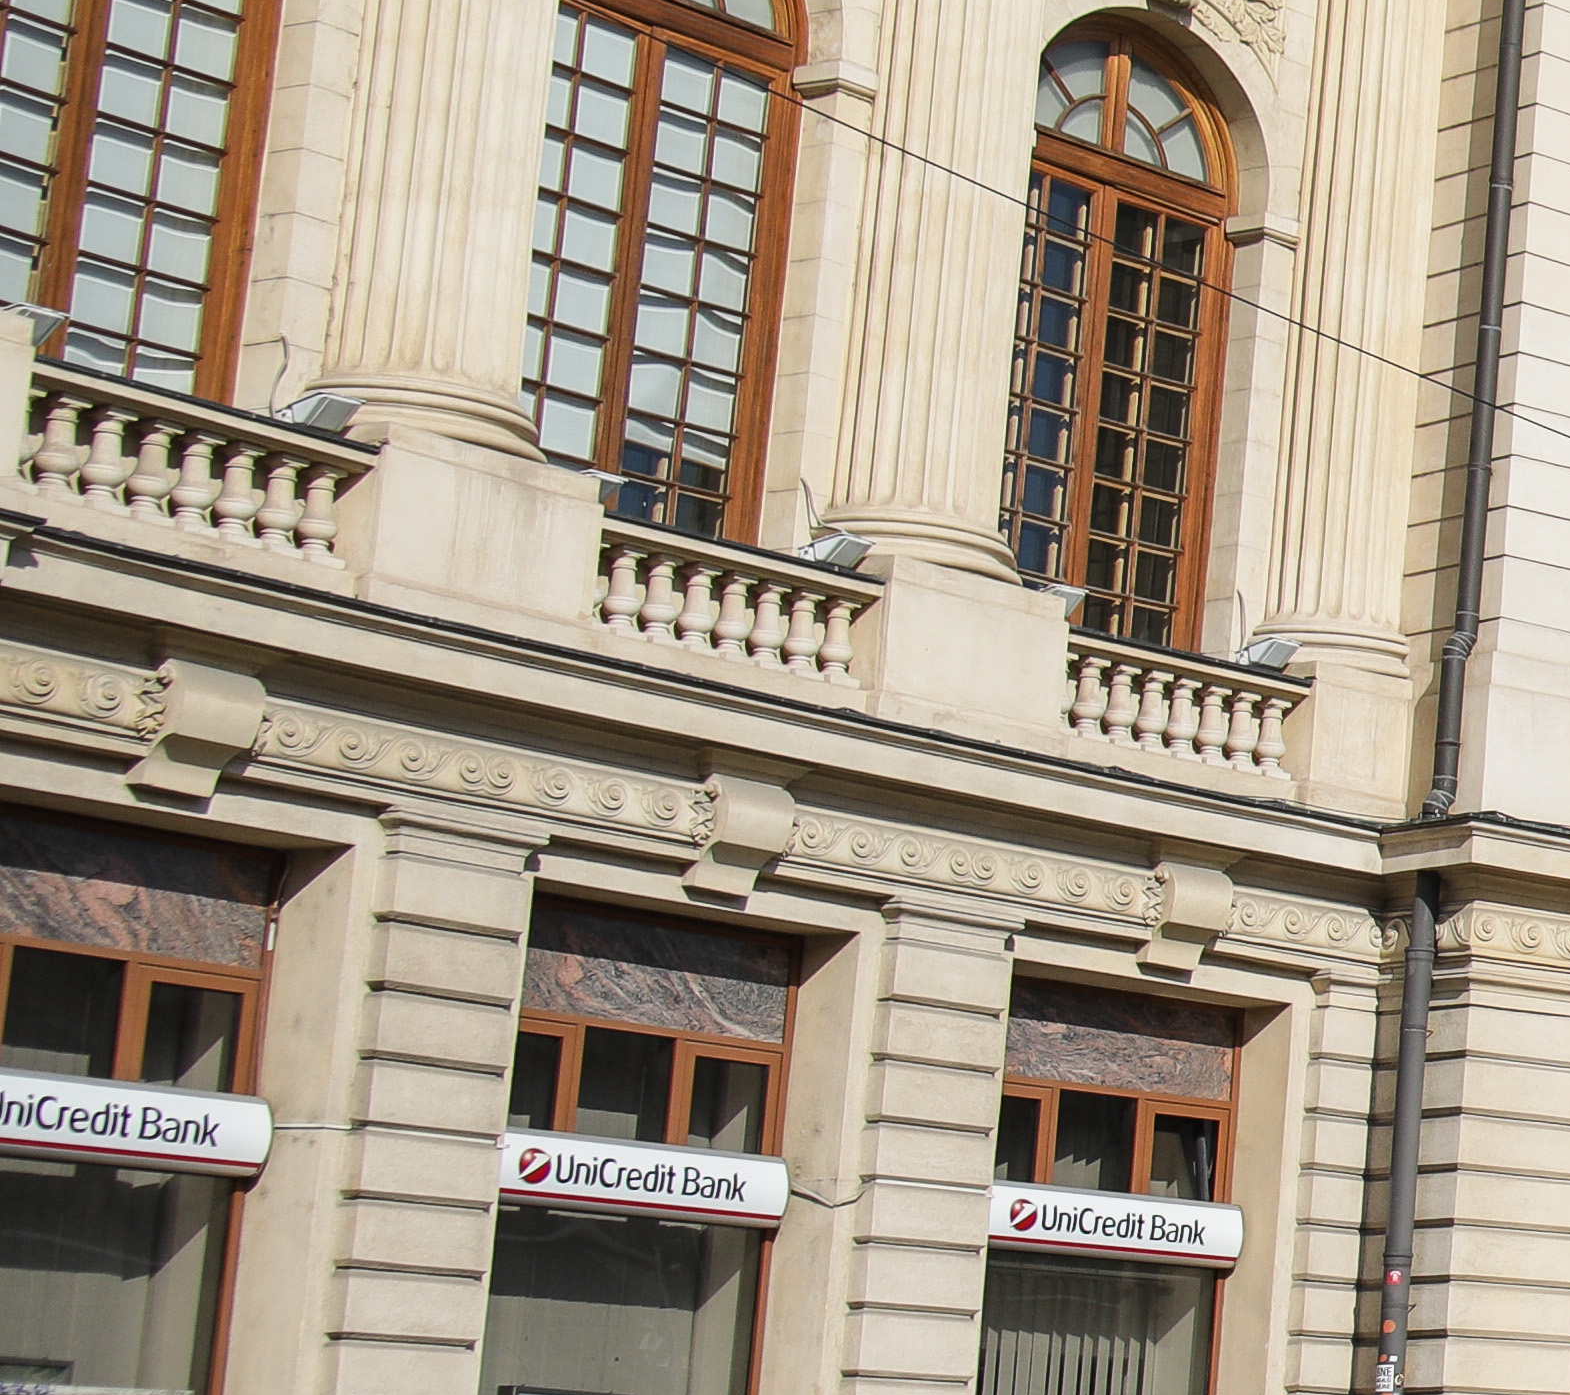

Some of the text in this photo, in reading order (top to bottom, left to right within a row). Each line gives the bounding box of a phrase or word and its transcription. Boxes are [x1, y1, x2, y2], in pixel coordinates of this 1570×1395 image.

[138, 1106, 220, 1148] Bank
[555, 1152, 747, 1203] UniCredit Bank
[1041, 1203, 1206, 1247] UniCredit Bank
